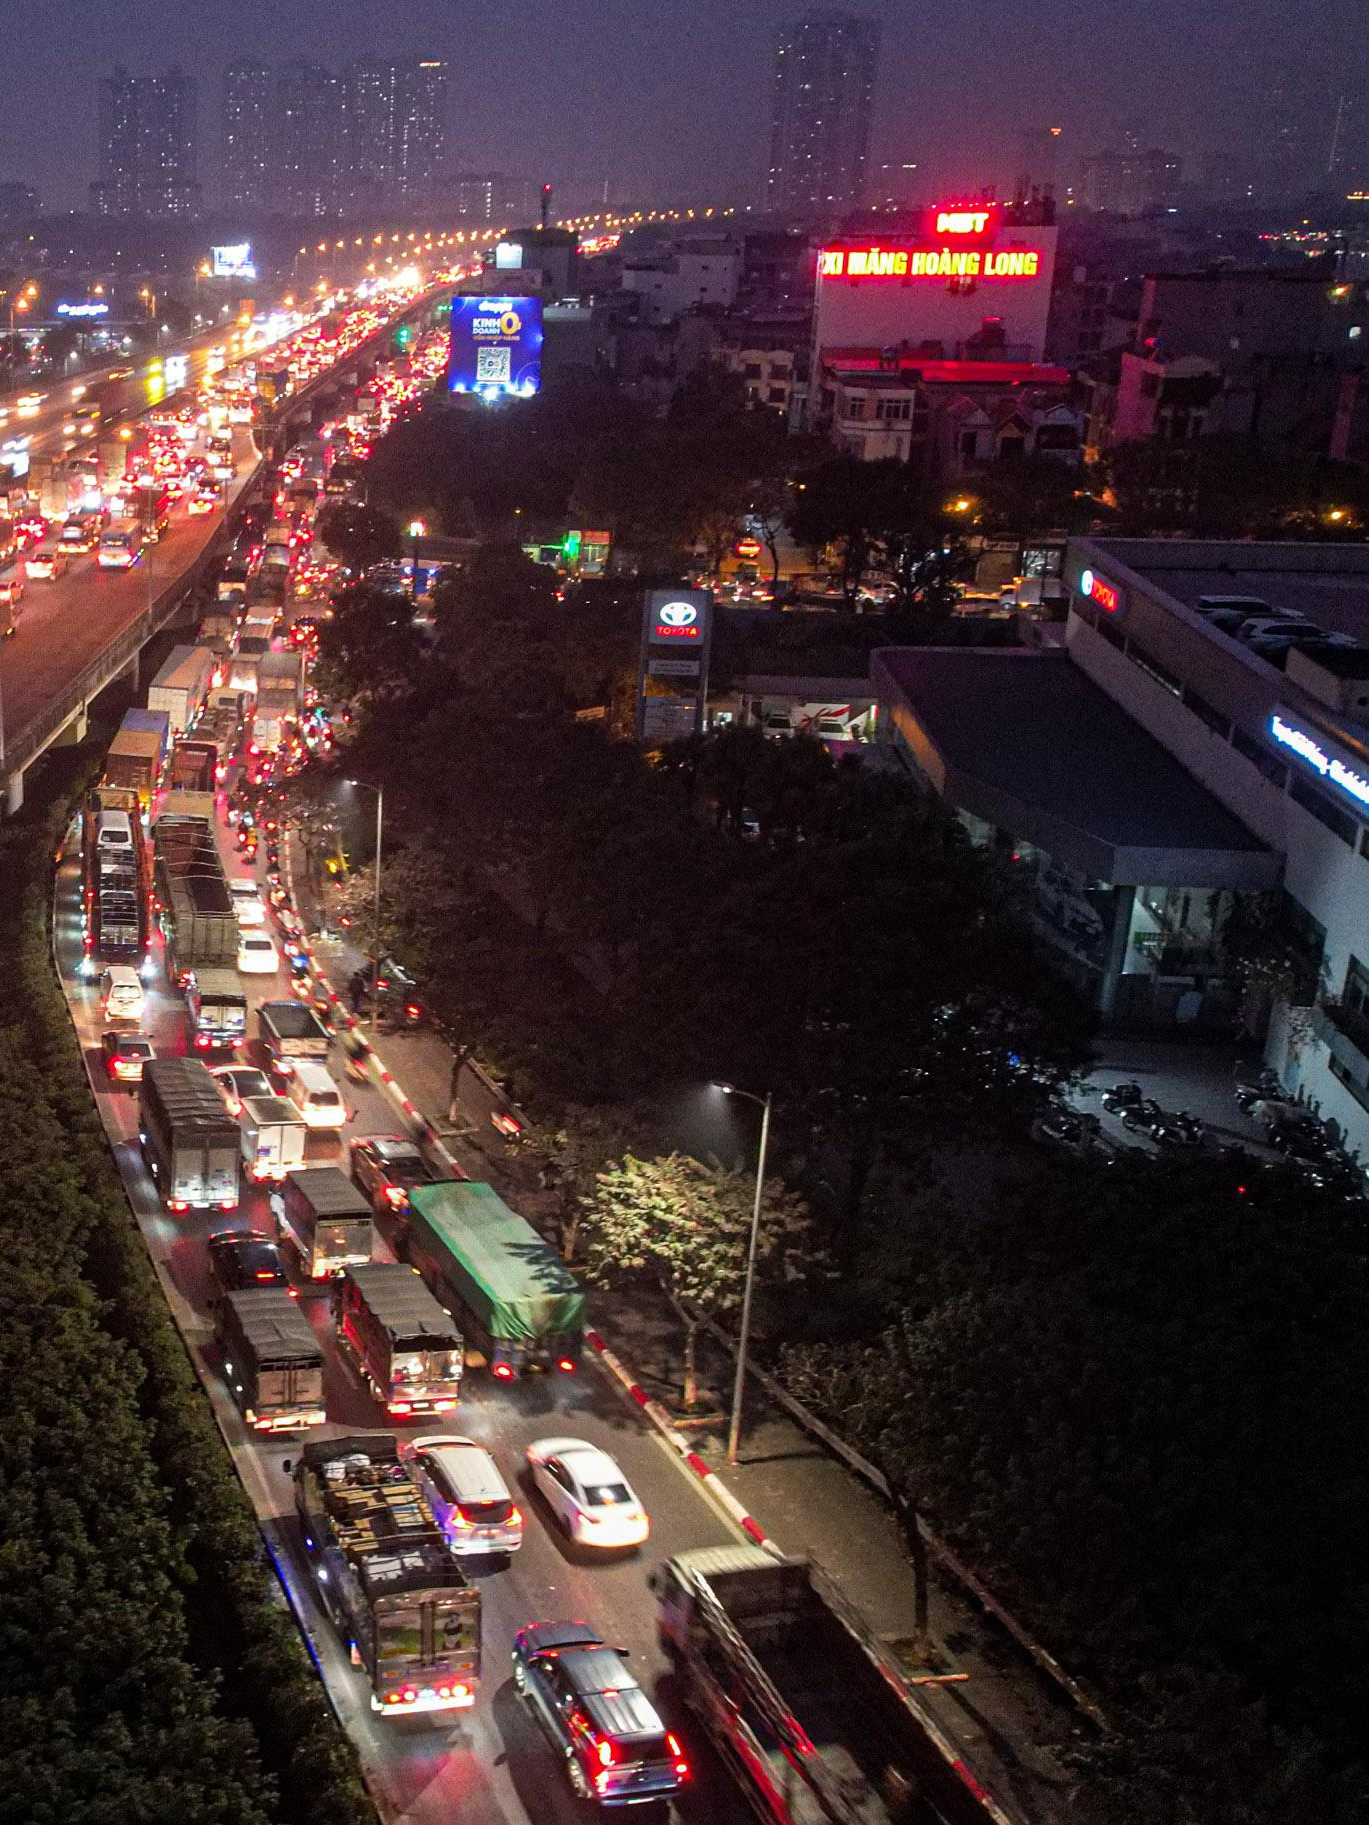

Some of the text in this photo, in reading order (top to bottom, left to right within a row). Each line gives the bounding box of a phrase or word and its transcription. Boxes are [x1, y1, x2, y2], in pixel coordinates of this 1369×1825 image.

[823, 248, 1039, 276] XI MĂNG HOÀNG LONG
[473, 318, 500, 328] KINH
[658, 626, 697, 636] TOYOTA
